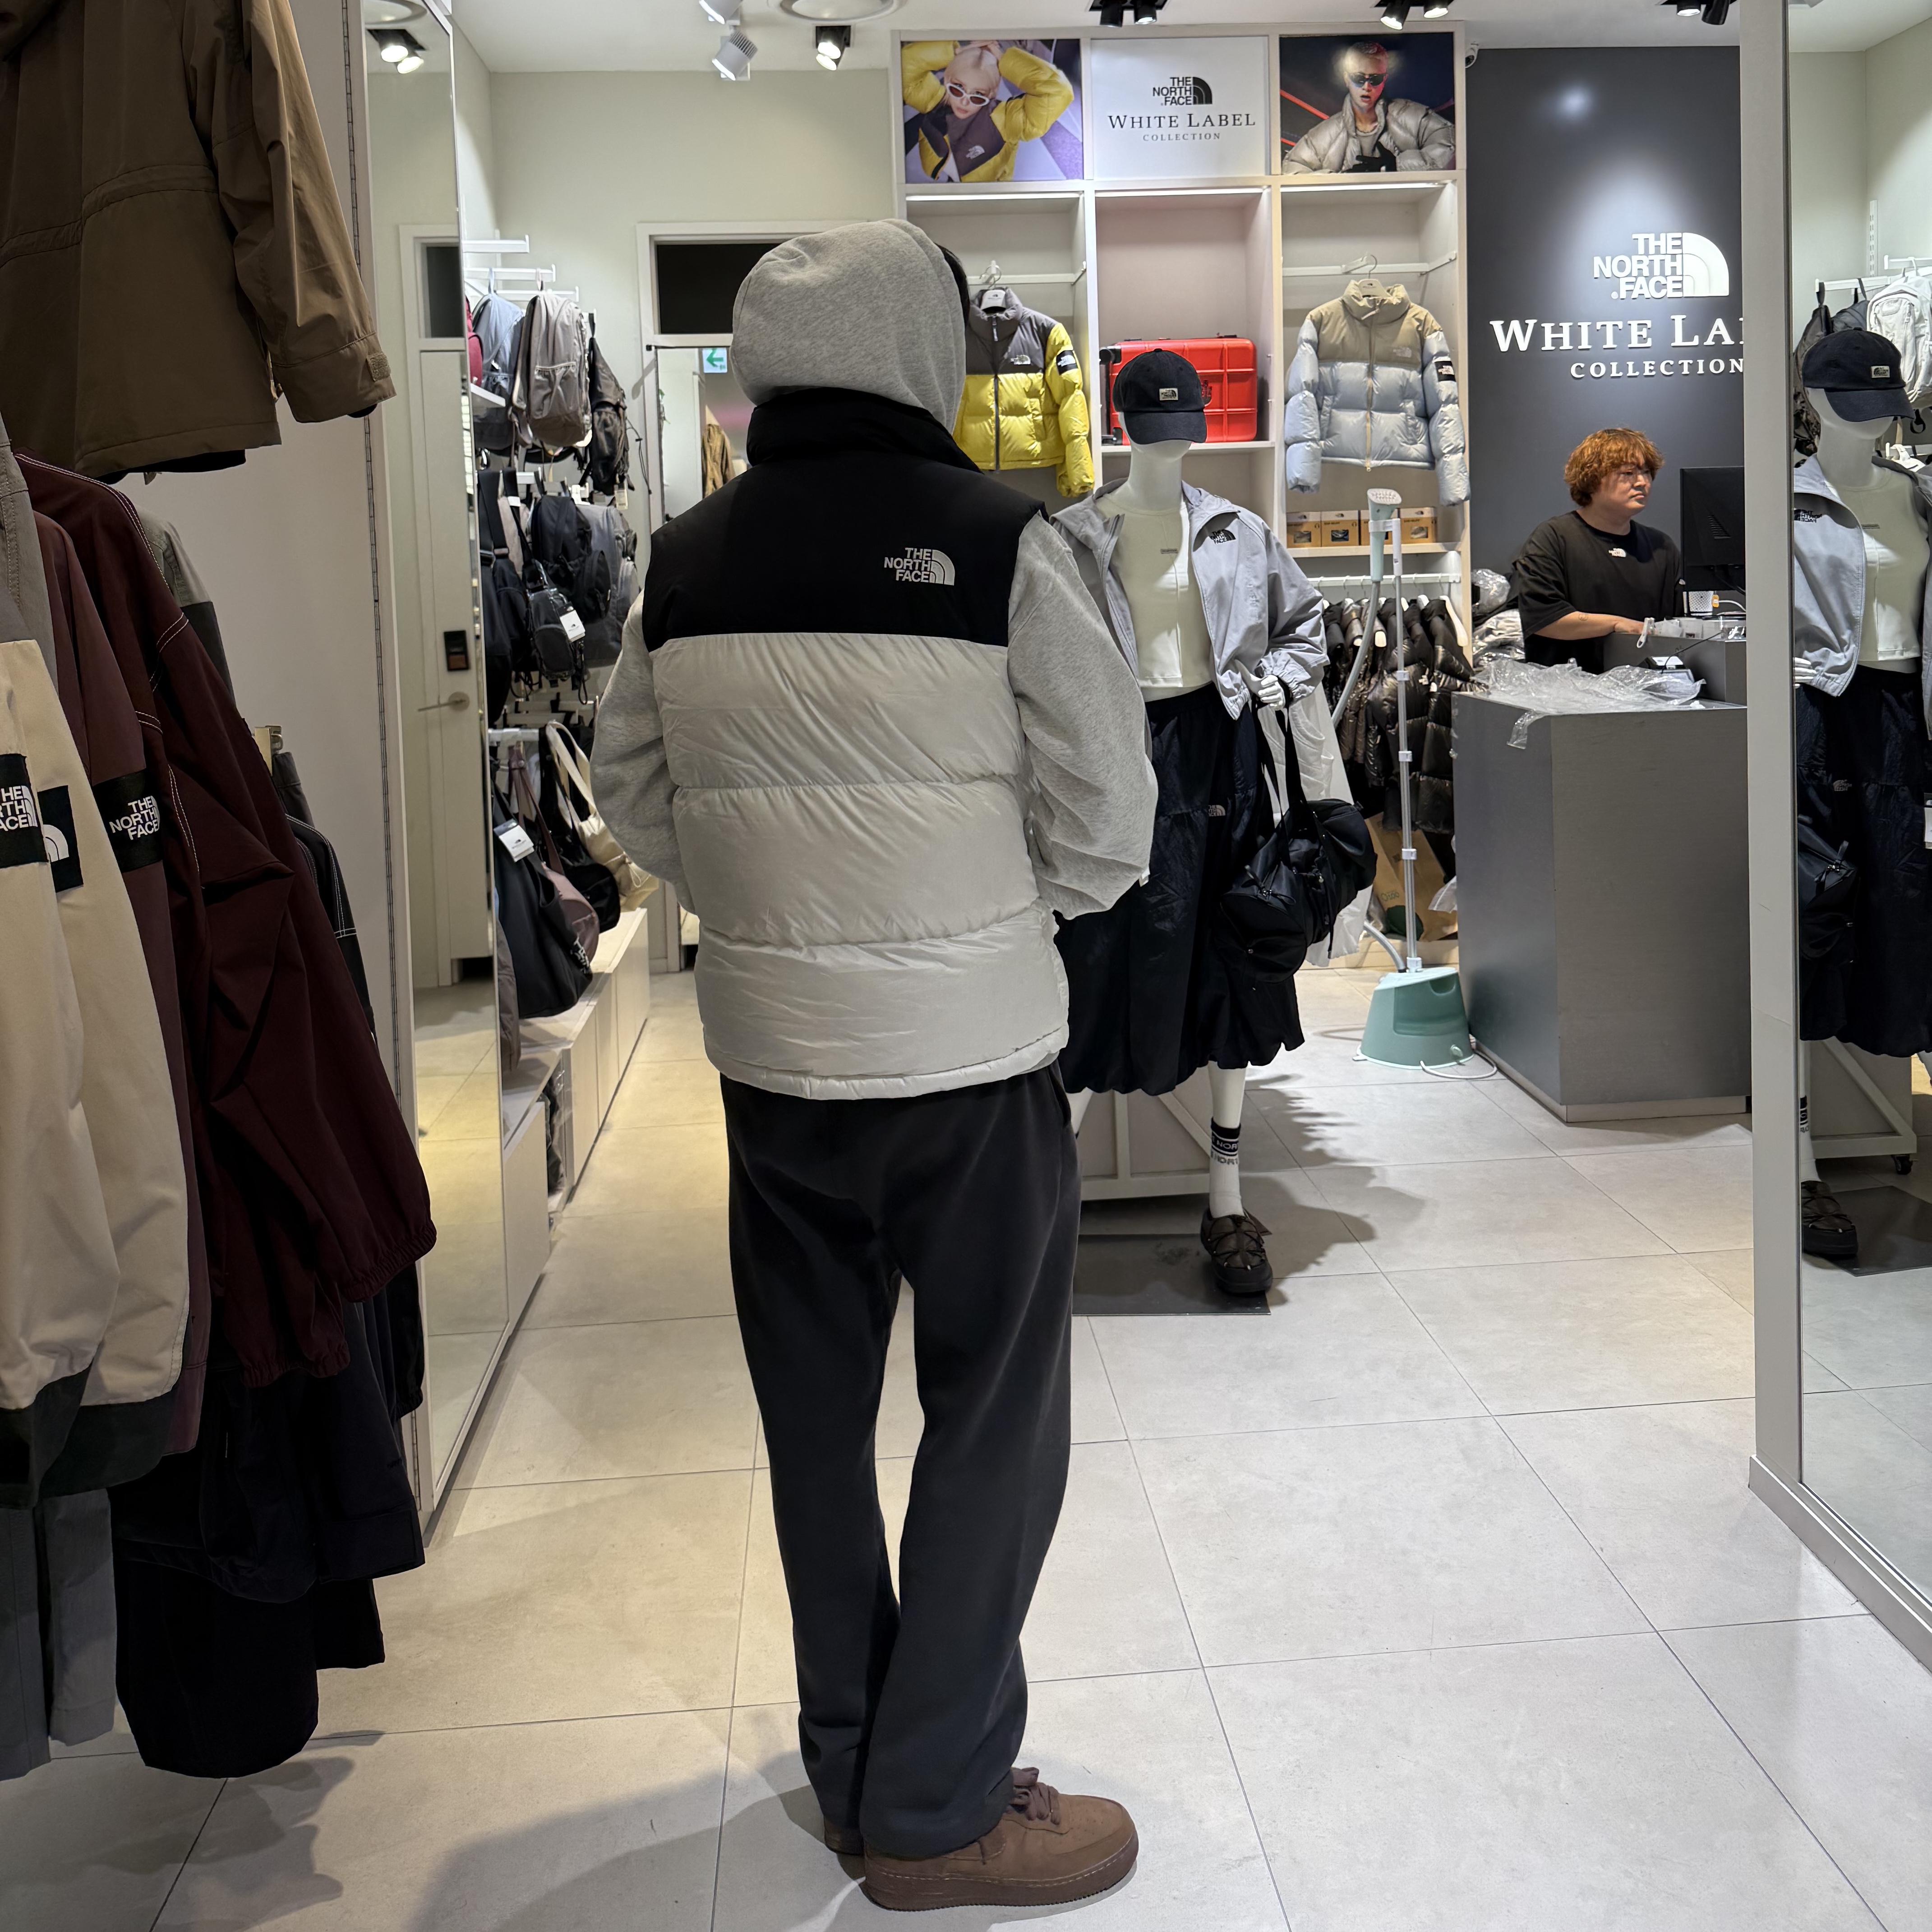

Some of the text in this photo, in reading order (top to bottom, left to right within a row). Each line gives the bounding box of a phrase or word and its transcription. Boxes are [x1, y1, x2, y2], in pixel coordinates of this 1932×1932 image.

[1170, 77, 1192, 86] THE
[1153, 87, 1192, 97] NORTH
[1164, 96, 1192, 106] FACE
[1108, 114, 1256, 129] WHITE LABEL
[1143, 133, 1221, 141] COLLECTION
[1632, 233, 1683, 255] THE
[1593, 255, 1683, 278] NORTH
[1619, 276, 1683, 299] FACE
[1489, 315, 1744, 352] WHITE LA
[1571, 359, 1743, 378] COLLECTION
[905, 547, 931, 560] THE
[884, 557, 931, 571] NORTH
[896, 570, 930, 583] FACE
[128, 796, 154, 811] THE
[109, 807, 157, 833] NORTH
[127, 819, 160, 841] FACE
